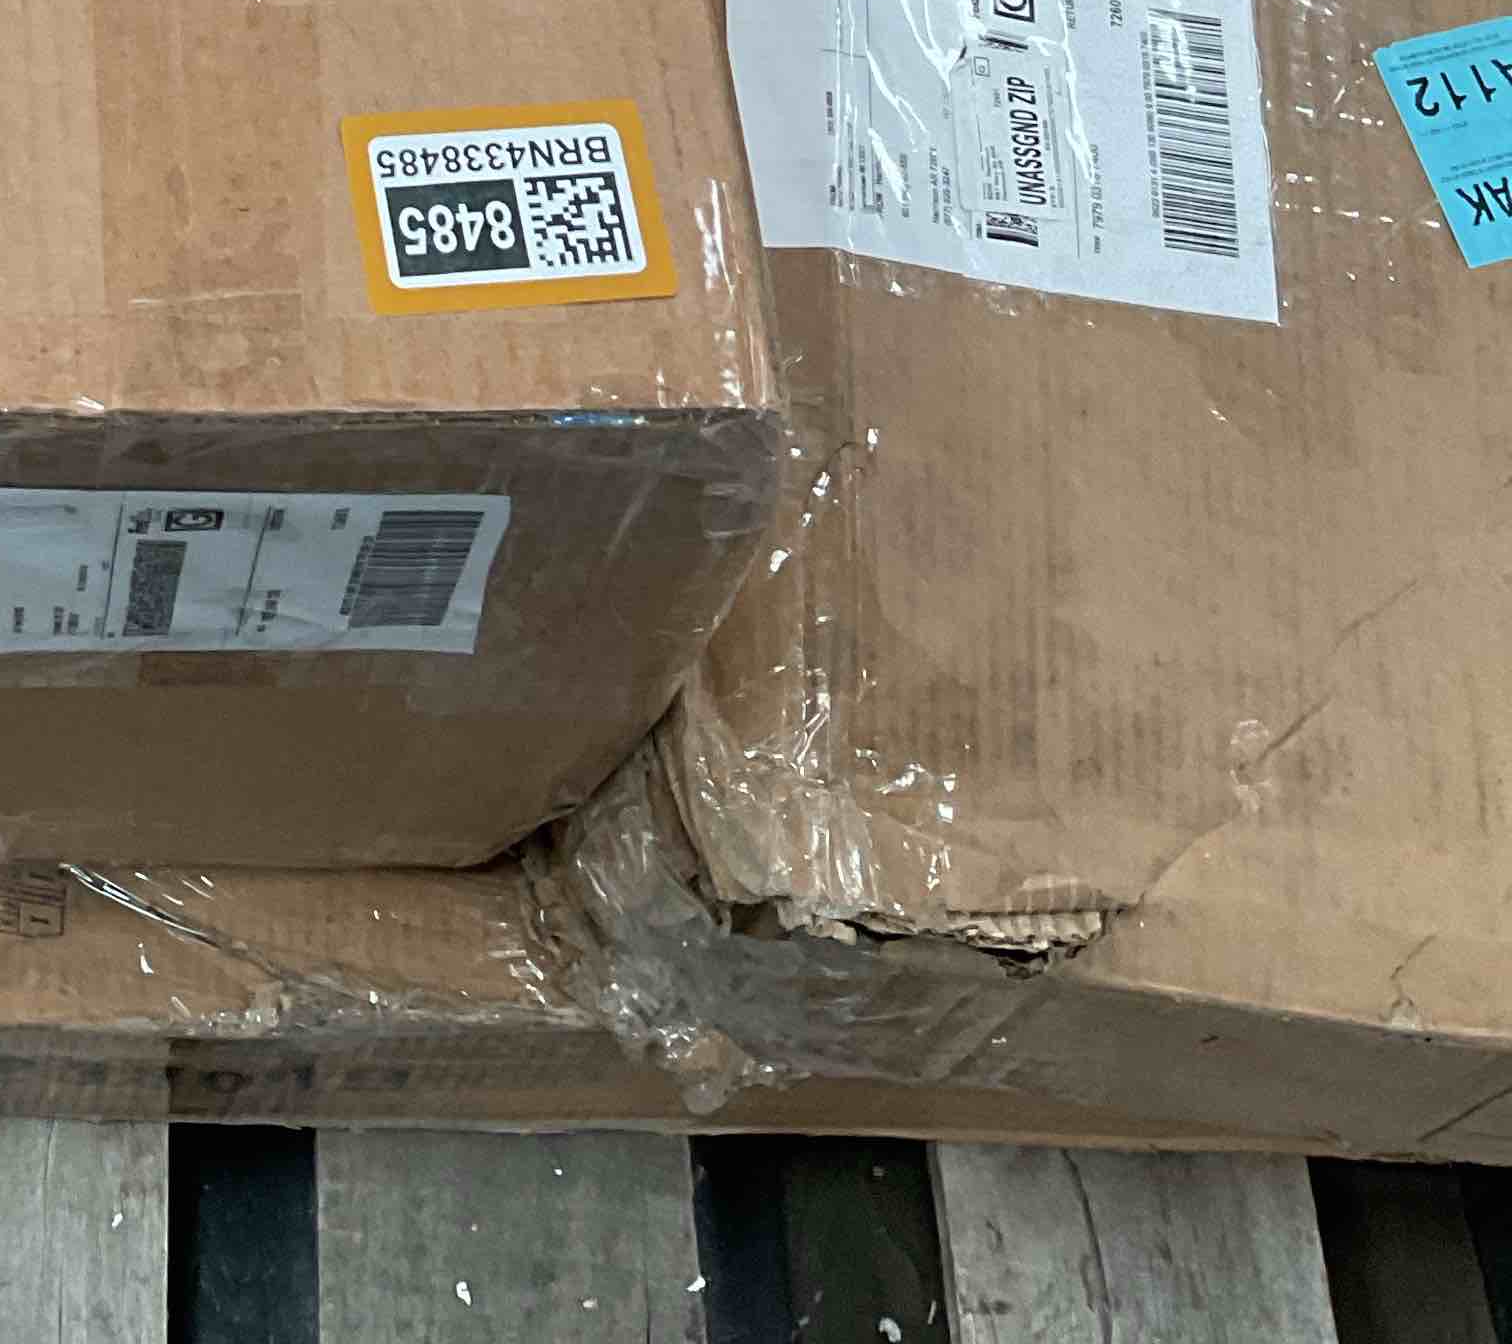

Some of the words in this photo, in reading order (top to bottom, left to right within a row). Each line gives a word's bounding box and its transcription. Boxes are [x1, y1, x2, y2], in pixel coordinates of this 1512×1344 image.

[1006, 75, 1040, 106] ZIP
[376, 135, 612, 179] BRN4338485
[1008, 109, 1047, 205] UNASSGND
[1455, 176, 1512, 227] AK
[398, 200, 517, 256] 8485
